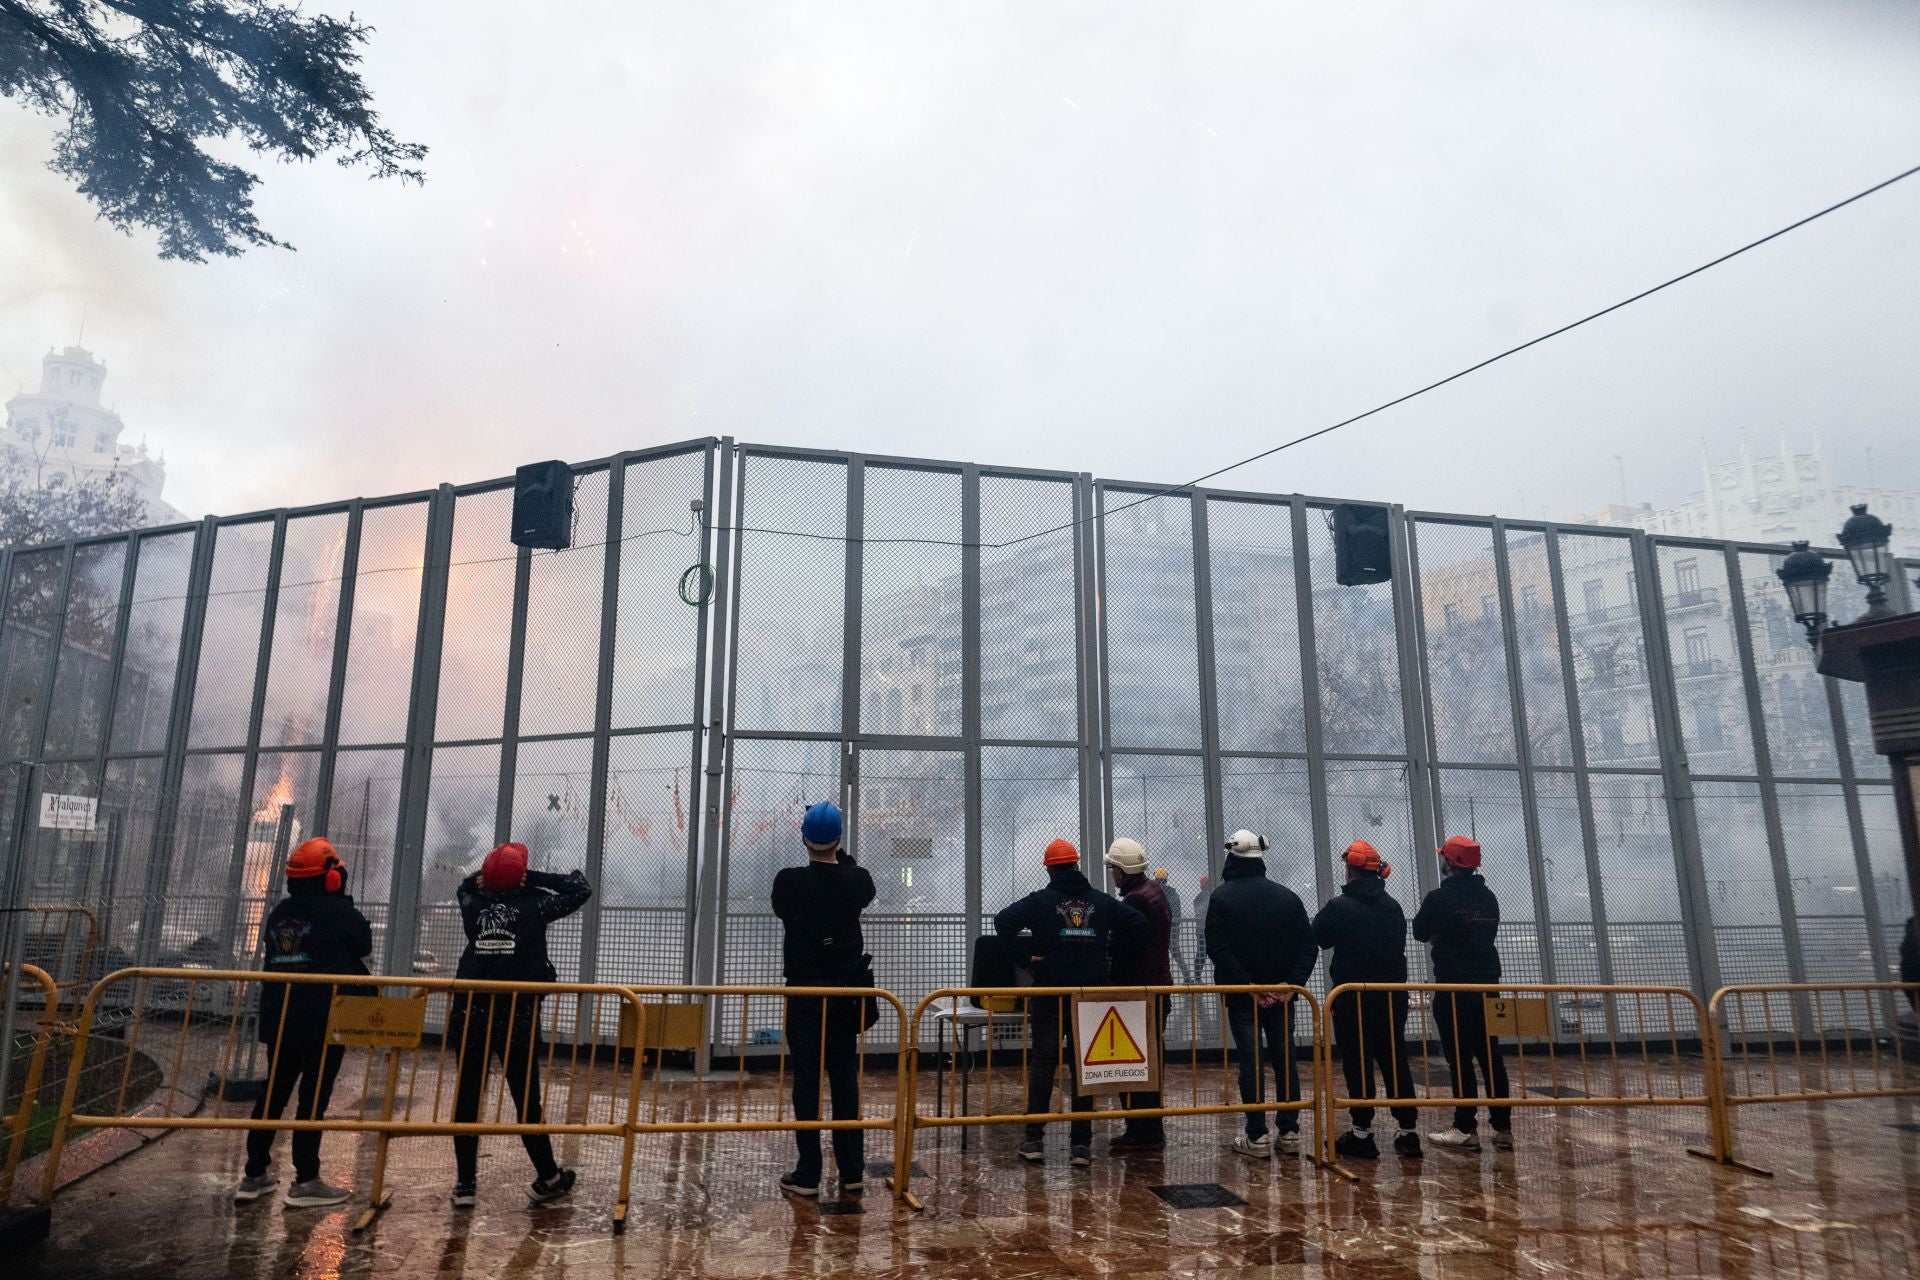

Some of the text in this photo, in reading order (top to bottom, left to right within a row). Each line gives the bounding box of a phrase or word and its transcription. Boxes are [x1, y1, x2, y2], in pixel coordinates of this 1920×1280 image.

[477, 928, 516, 940] PIROTECNIA
[1085, 1069, 1146, 1080] ZONA DE FUEGOS
